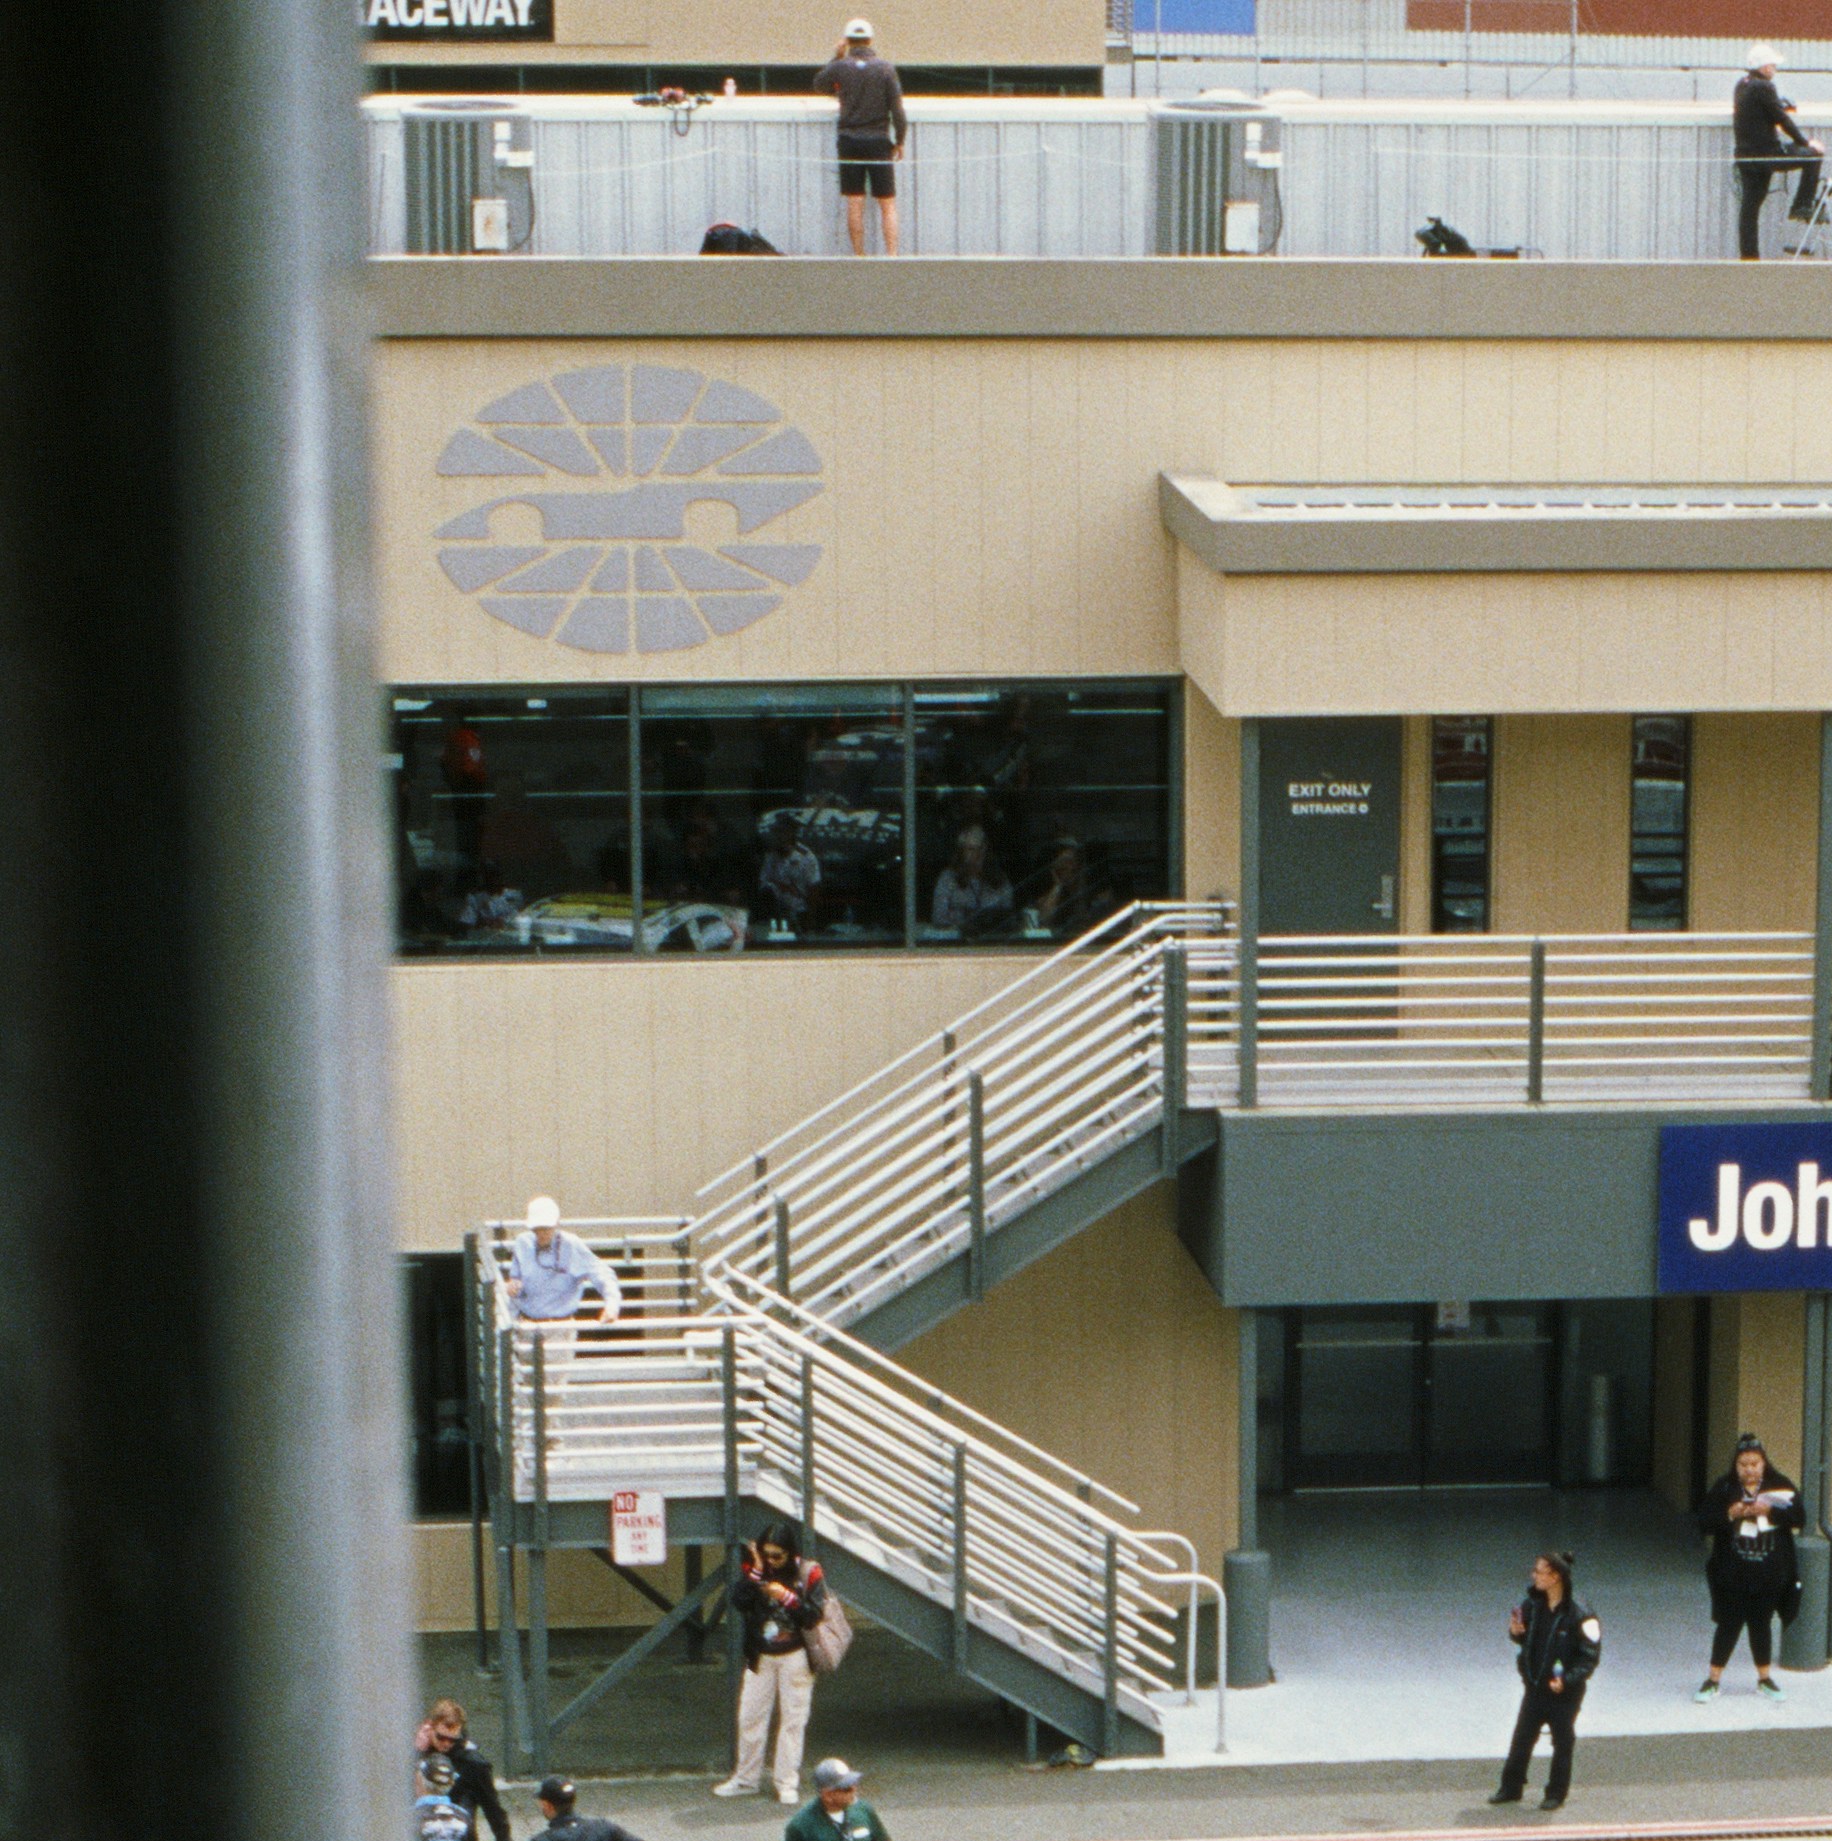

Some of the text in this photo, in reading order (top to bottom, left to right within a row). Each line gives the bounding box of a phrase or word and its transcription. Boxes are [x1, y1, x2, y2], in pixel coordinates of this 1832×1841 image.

[367, 0, 535, 27] ACEWAY
[1289, 783, 1372, 797] EXIT ONLY
[1291, 803, 1357, 815] ENTRANCE
[615, 1494, 635, 1511] NO
[617, 1514, 662, 1529] PARKING
